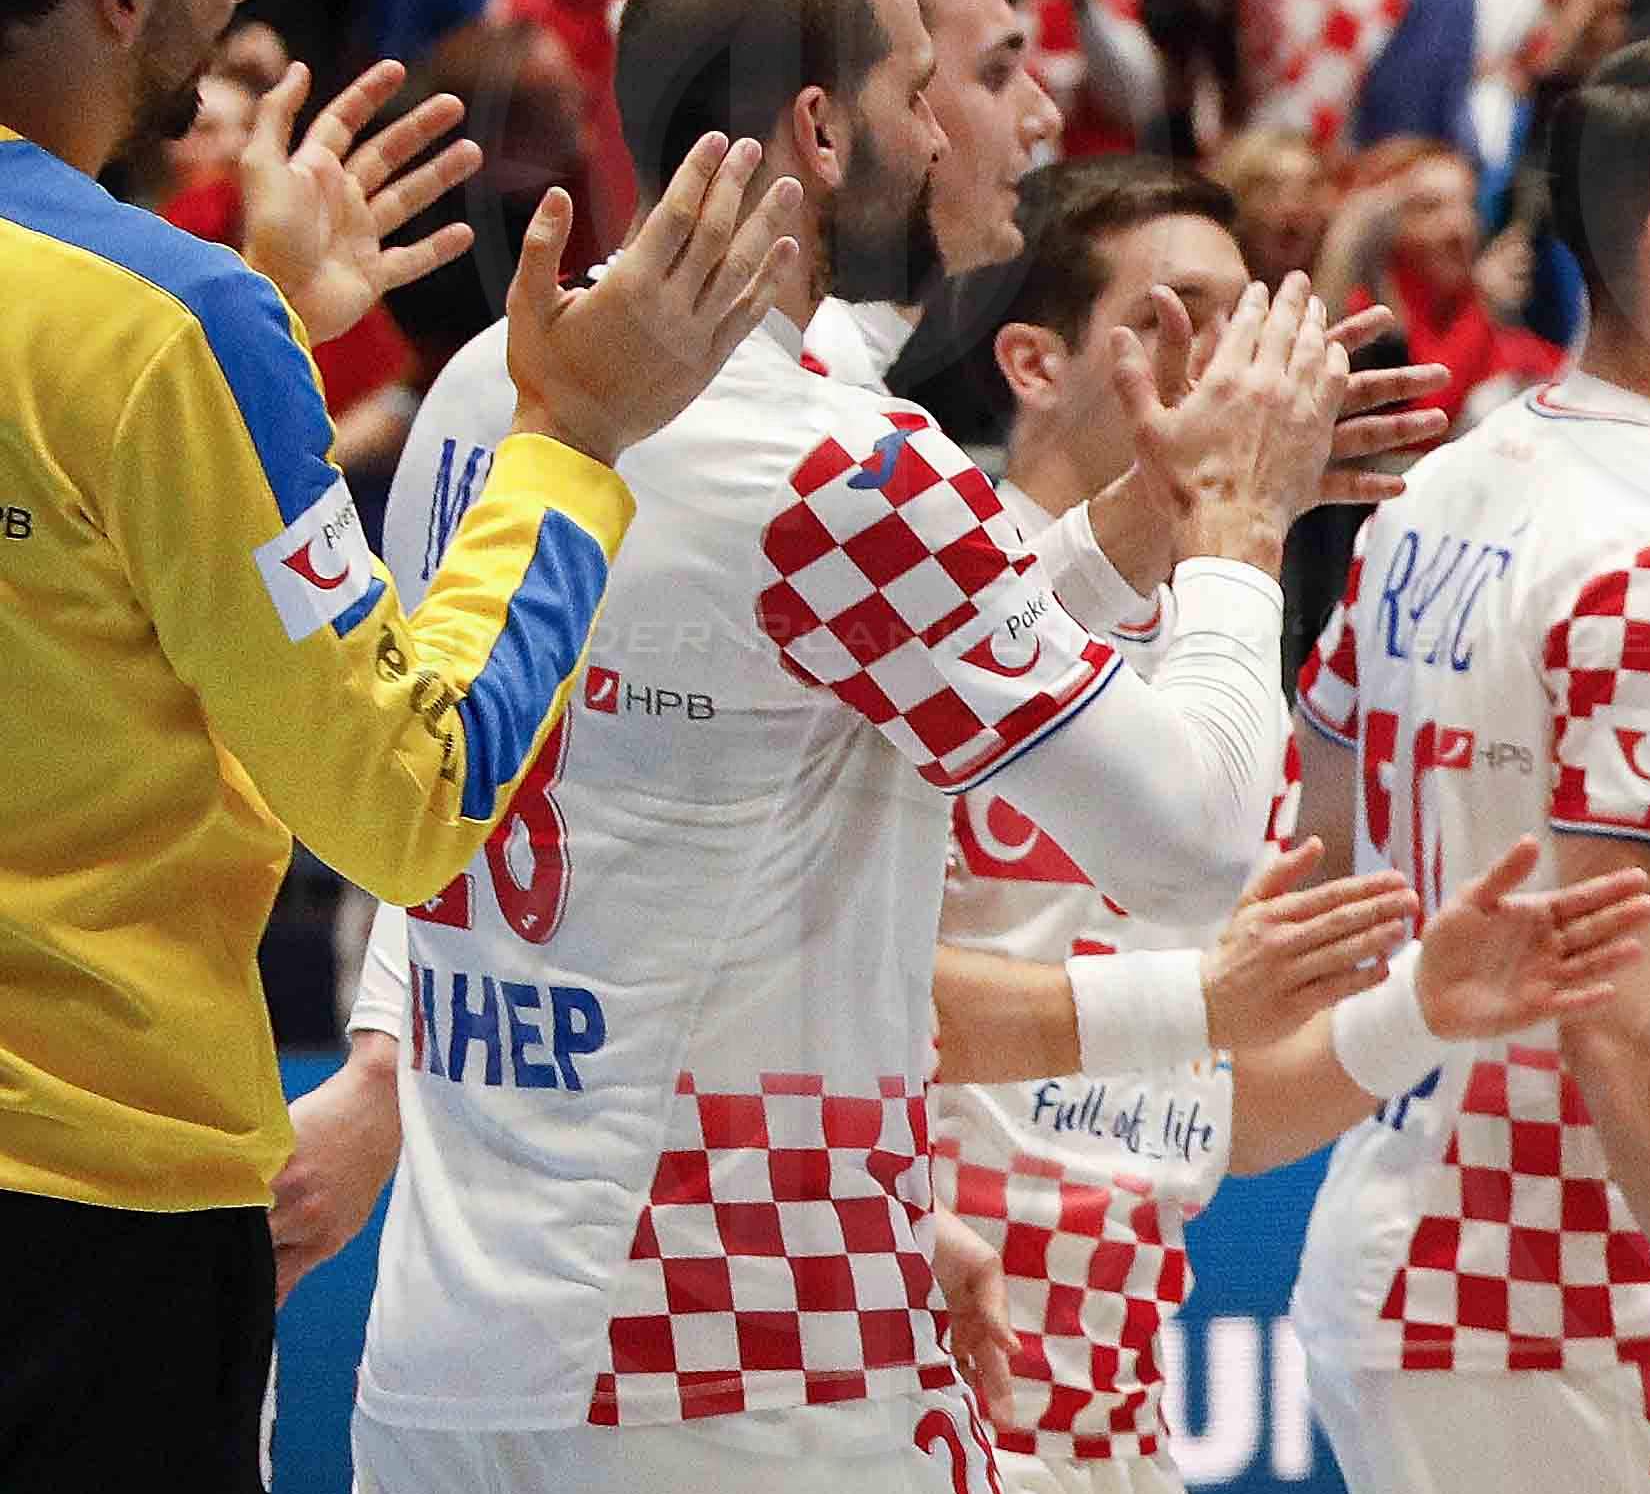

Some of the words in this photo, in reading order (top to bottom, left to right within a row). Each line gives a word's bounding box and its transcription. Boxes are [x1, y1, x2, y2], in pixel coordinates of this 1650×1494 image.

[625, 684, 716, 722] HPB
[448, 971, 609, 1093] HEP
[1031, 1080, 1106, 1139] Full
[1112, 1092, 1148, 1154] of
[1162, 1096, 1214, 1163] life
